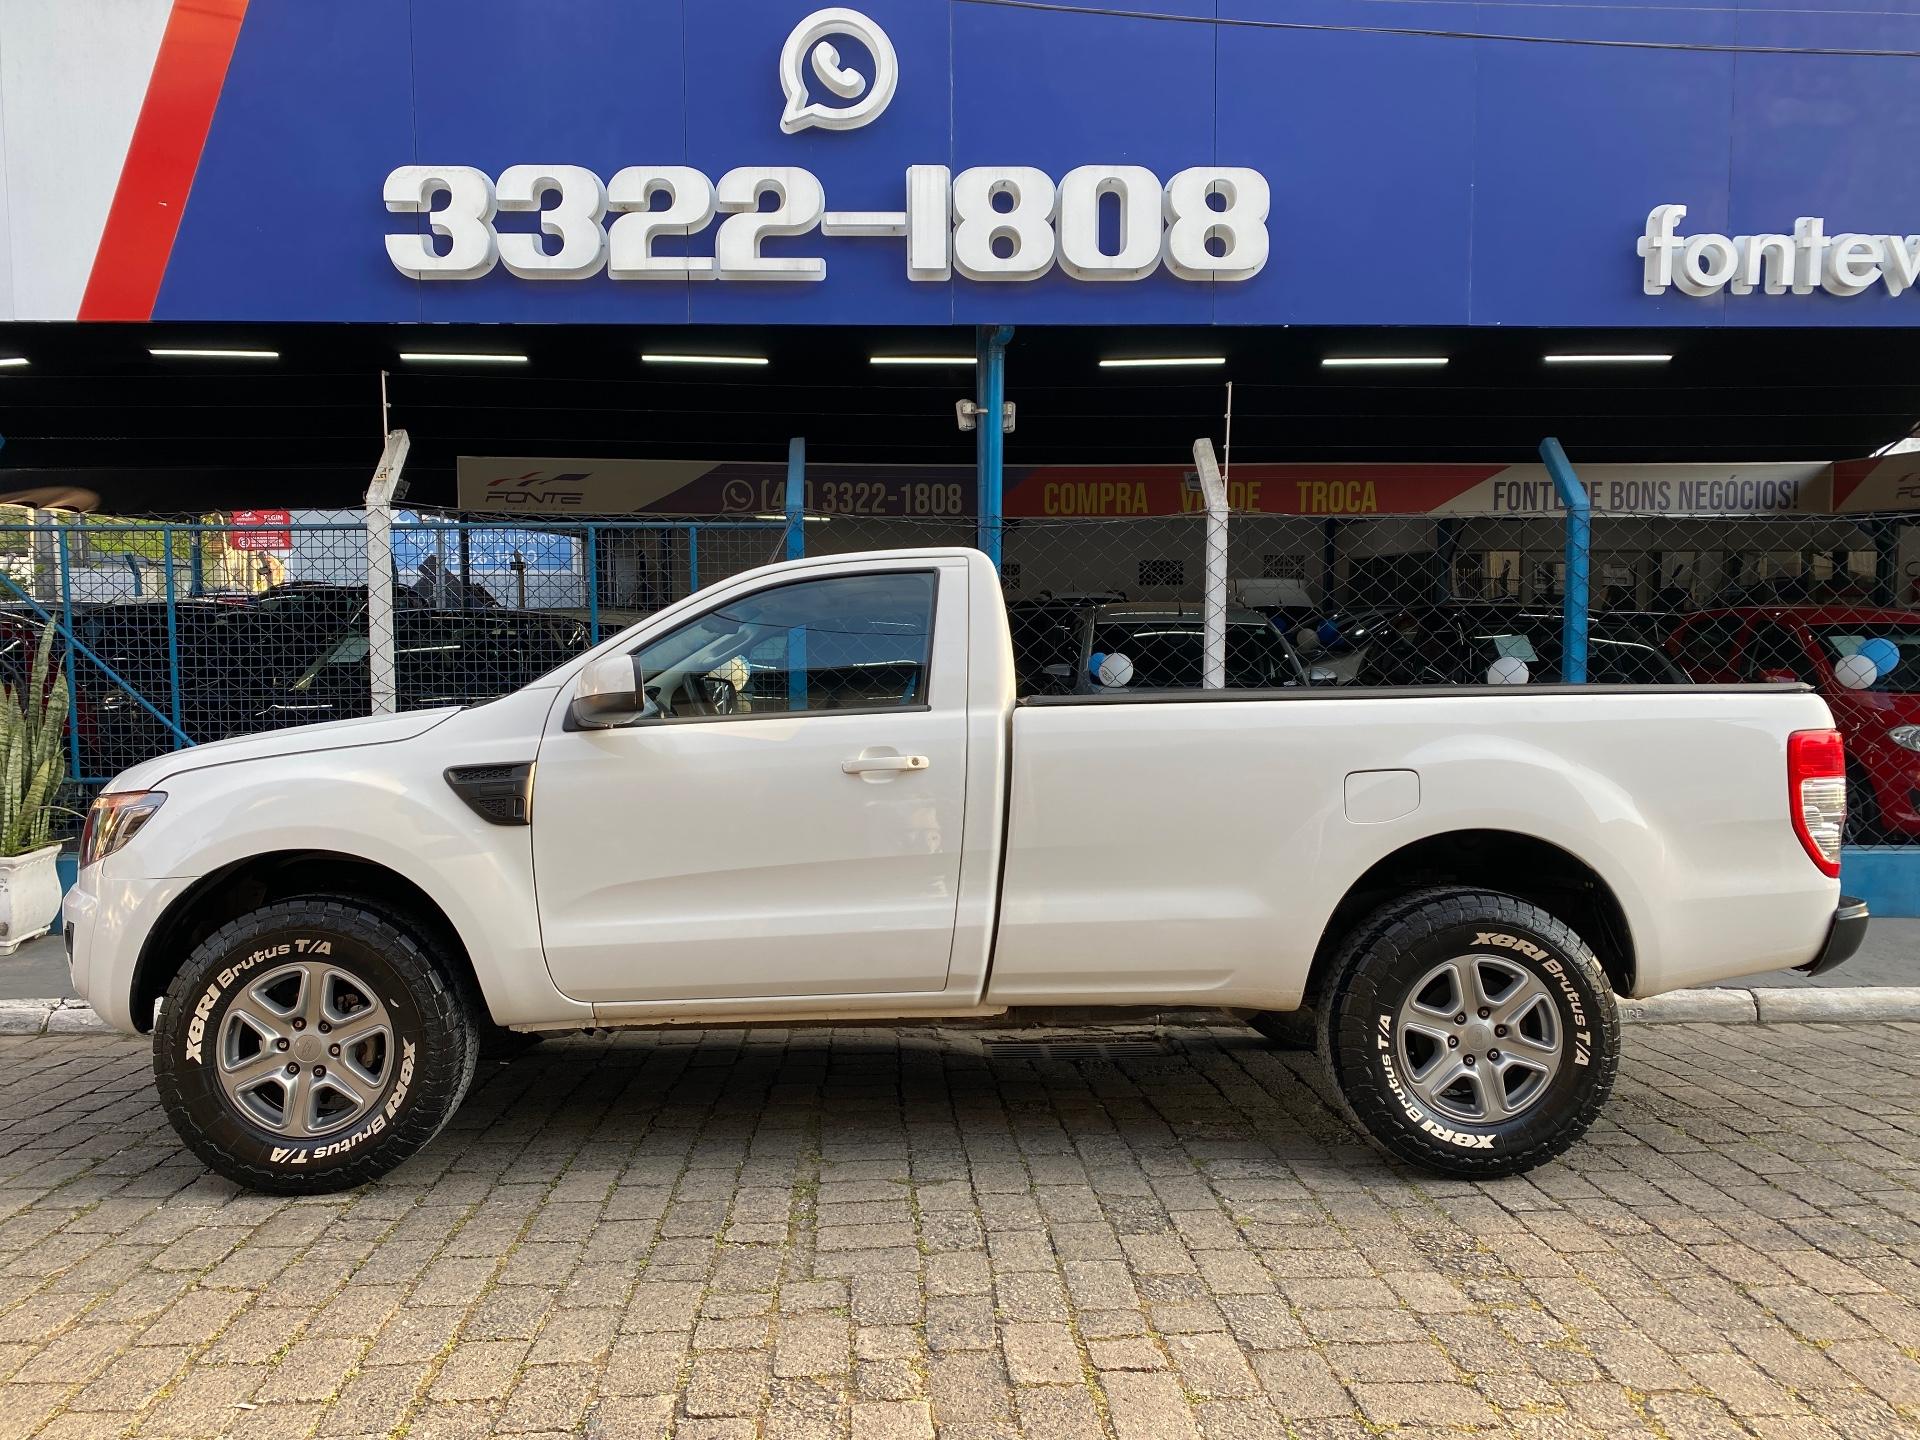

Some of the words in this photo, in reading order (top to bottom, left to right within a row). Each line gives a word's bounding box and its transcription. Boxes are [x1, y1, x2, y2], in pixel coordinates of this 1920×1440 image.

[383, 164, 1270, 281] 3322-1808
[485, 491, 584, 505] FONTE
[822, 482, 962, 514] 3322-1808
[1043, 481, 1149, 515] COMPRA
[1296, 480, 1377, 513] TROCA
[1610, 480, 1671, 511] BONS
[1678, 475, 1800, 511] NEGÓCIOS!
[186, 983, 221, 1065] XBRI
[217, 943, 291, 989] Brutus
[294, 939, 332, 956] T/A
[1469, 932, 1550, 962] XBRI
[1542, 957, 1586, 1027] Brutus
[1574, 1030, 1592, 1066] T/A
[1377, 1014, 1392, 1050] T/A
[384, 1036, 416, 1120] XBRI
[1381, 1053, 1425, 1123] Brutus
[313, 1113, 388, 1159] Brutus
[1420, 1118, 1497, 1149] XBRI
[269, 1146, 308, 1164] T/A
